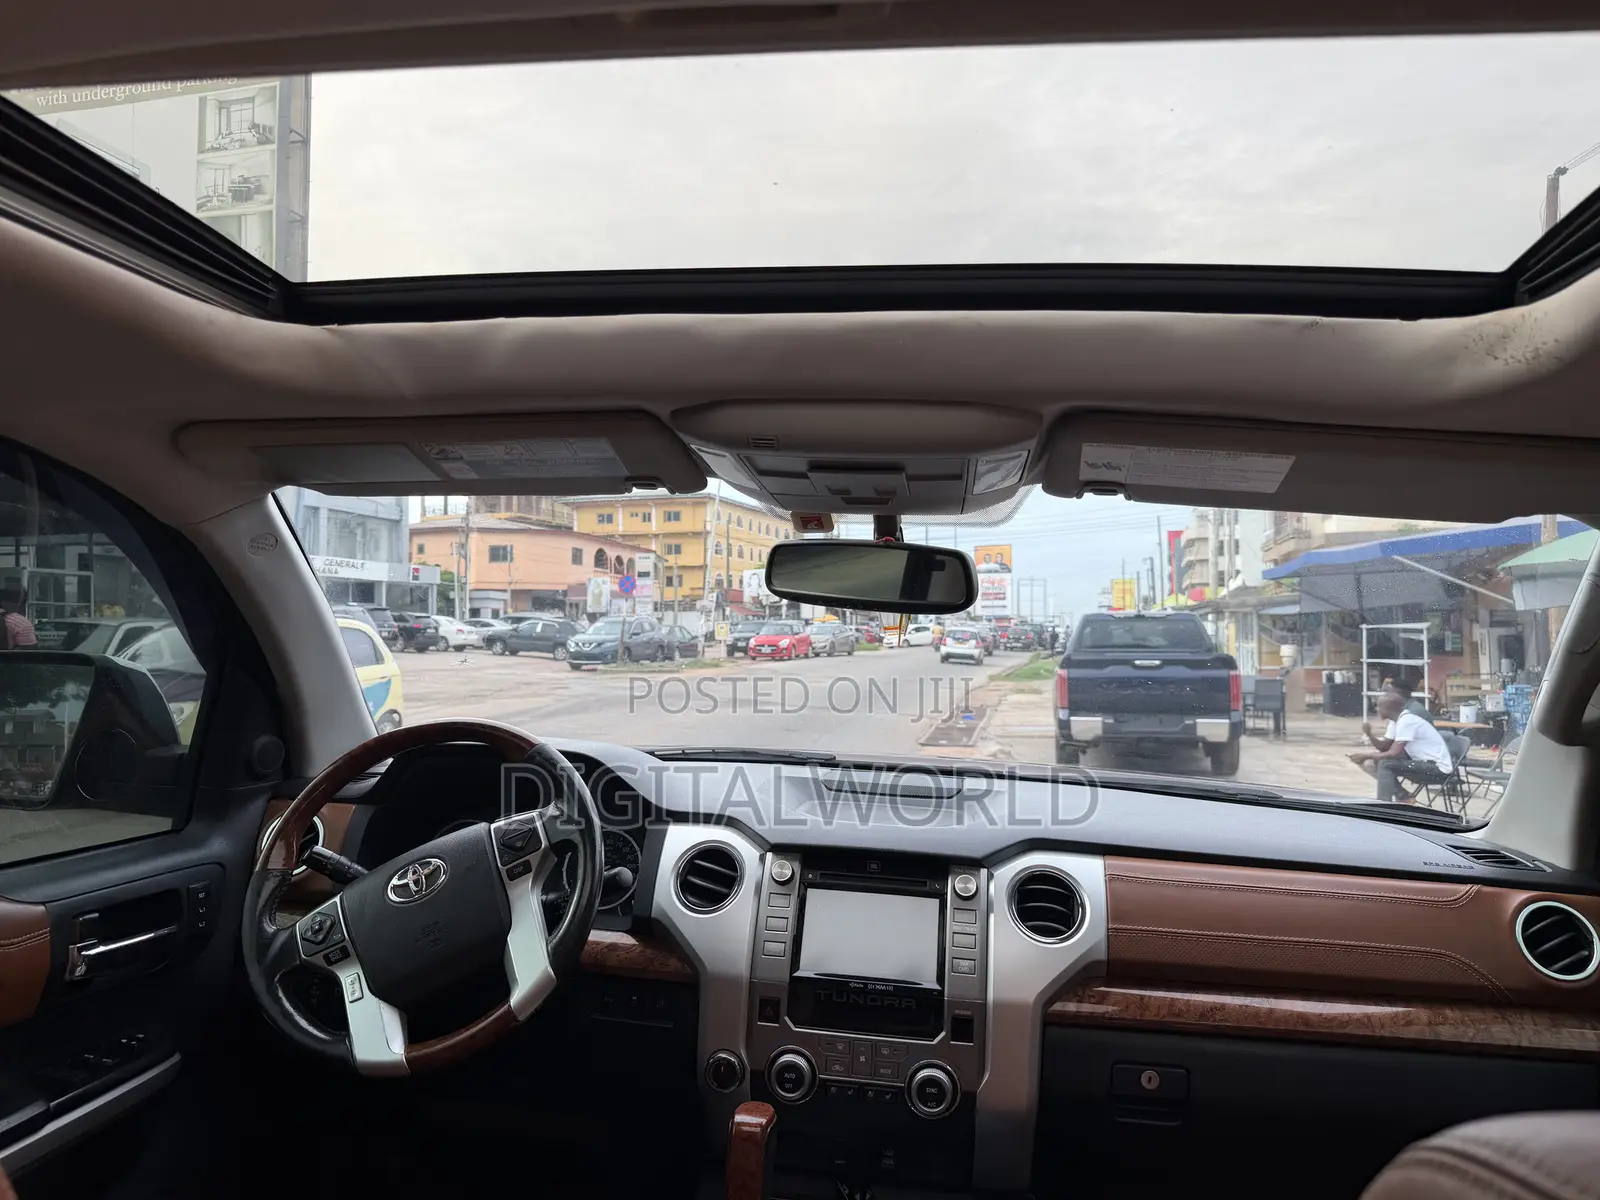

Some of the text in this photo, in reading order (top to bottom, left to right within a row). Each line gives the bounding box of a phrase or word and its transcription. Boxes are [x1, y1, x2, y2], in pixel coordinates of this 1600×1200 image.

[36, 89, 68, 107] with
[72, 78, 172, 101] underground
[177, 76, 239, 92] parg
[816, 990, 917, 1009] TUNDRA
[783, 1071, 796, 1080] AUTO
